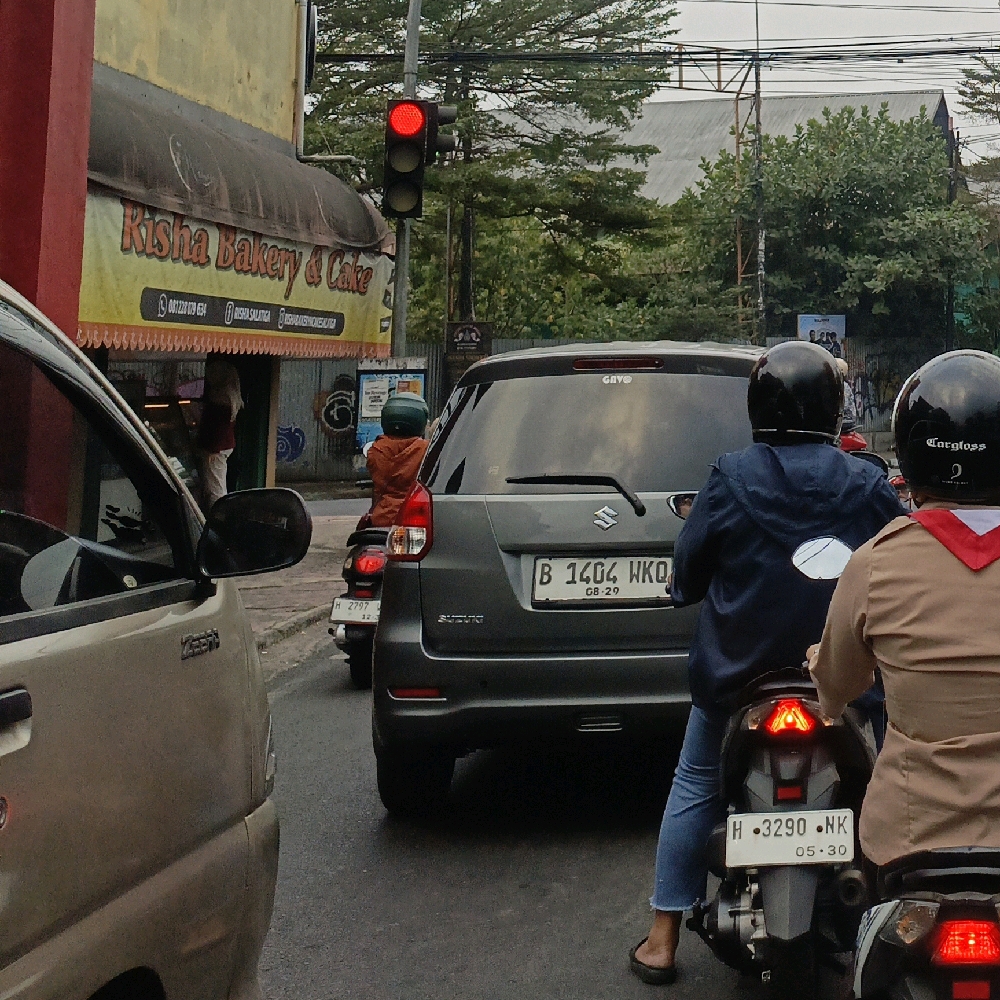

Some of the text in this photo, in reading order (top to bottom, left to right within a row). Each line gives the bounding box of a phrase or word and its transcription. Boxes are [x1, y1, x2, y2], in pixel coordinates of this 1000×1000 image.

[121, 197, 374, 300] Risha Bakery & Cake
[926, 437, 987, 452] Cargloss
[539, 560, 668, 586] B 1404 WKQ
[335, 601, 341, 610] H
[348, 601, 369, 611] 2797
[732, 815, 848, 840] H 3290 NK
